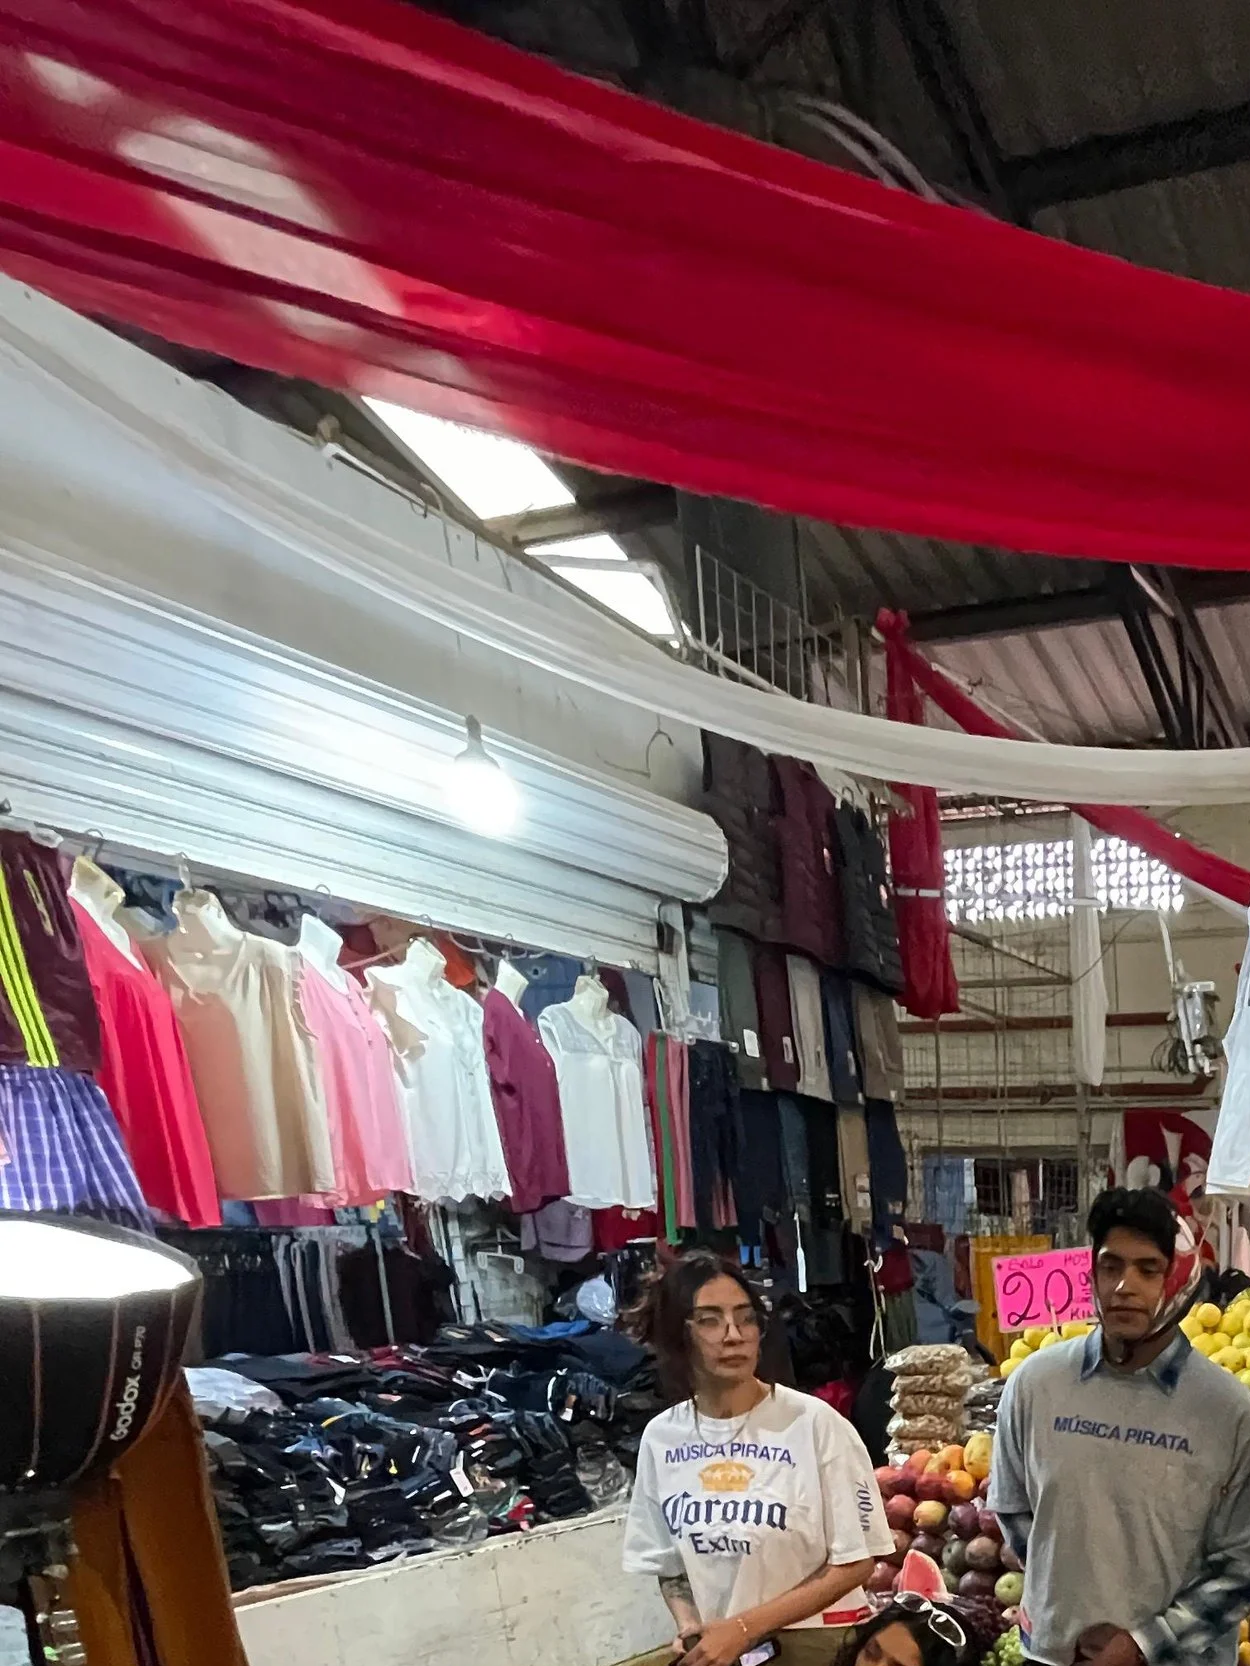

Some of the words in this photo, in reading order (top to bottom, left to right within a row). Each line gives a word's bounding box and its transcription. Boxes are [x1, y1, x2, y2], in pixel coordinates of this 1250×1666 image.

[110, 1374, 140, 1441] Godox
[1053, 1414, 1121, 1442] MÚSICA
[665, 1443, 726, 1465] MÚSICA
[661, 1491, 789, 1540] Corona
